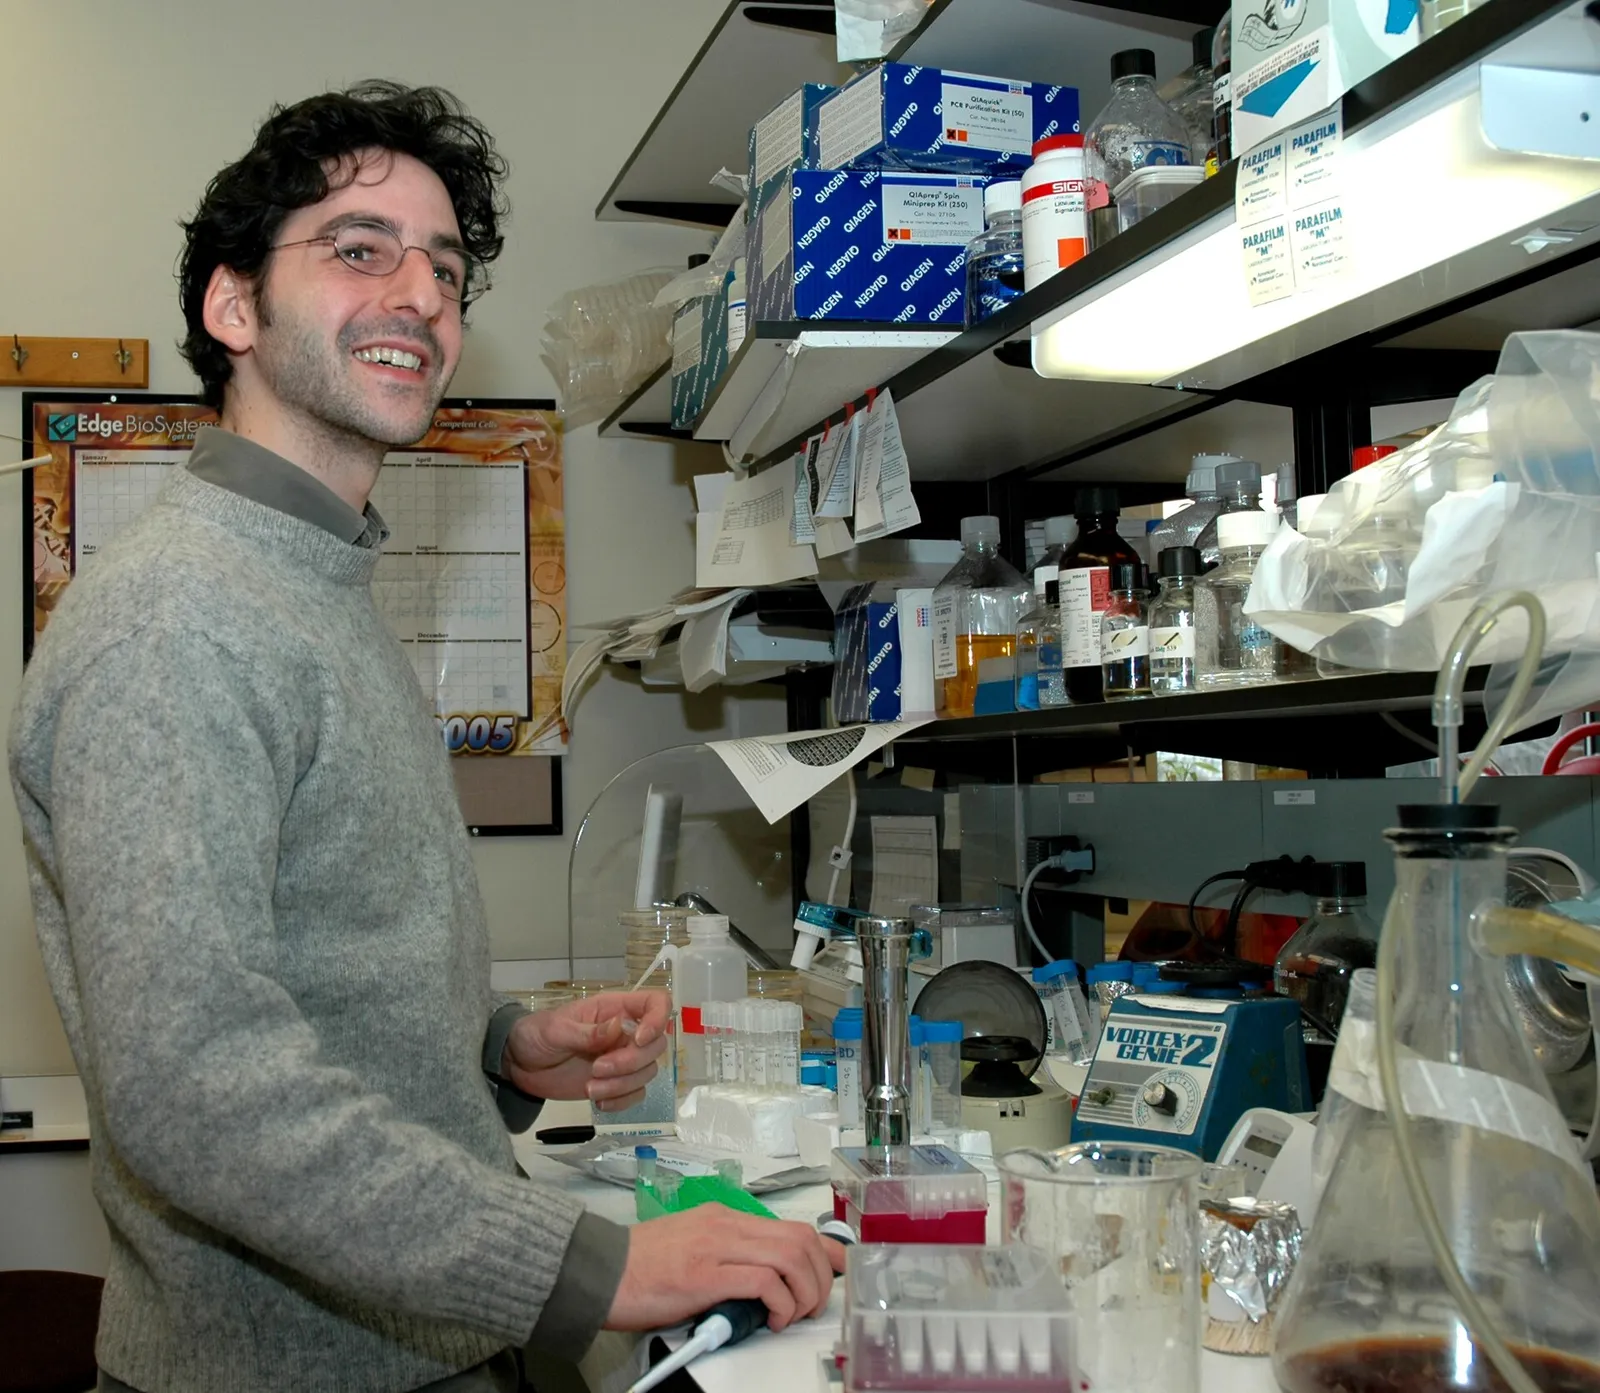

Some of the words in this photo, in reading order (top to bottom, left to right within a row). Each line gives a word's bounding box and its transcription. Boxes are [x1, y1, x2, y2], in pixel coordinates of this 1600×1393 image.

[890, 102, 918, 138] QIAGEN
[1292, 122, 1336, 150] PARAFILM
[1242, 144, 1281, 170] PARAFILM
[815, 170, 849, 204] QIAGEN
[944, 192, 960, 200] Spin
[844, 199, 878, 234] QIAGEN
[903, 200, 936, 208] Miniprep
[950, 201, 968, 209] (250)
[1296, 207, 1342, 232] PARAFILM
[797, 216, 831, 250] QIAGEN
[1243, 225, 1284, 249] PARAFILM
[826, 245, 860, 279] QIAGEN
[900, 258, 934, 292] QIAGEN
[854, 274, 888, 308] QIAGEN
[928, 288, 962, 321] QIAGEN
[78, 413, 123, 438] Edge
[434, 420, 477, 430] Competent
[478, 420, 498, 428] Cells
[416, 456, 432, 464] April
[867, 642, 892, 674] QIAGEN
[435, 714, 514, 750] 005
[1116, 1044, 1182, 1064] GENIE
[1180, 1034, 1218, 1068] 2
